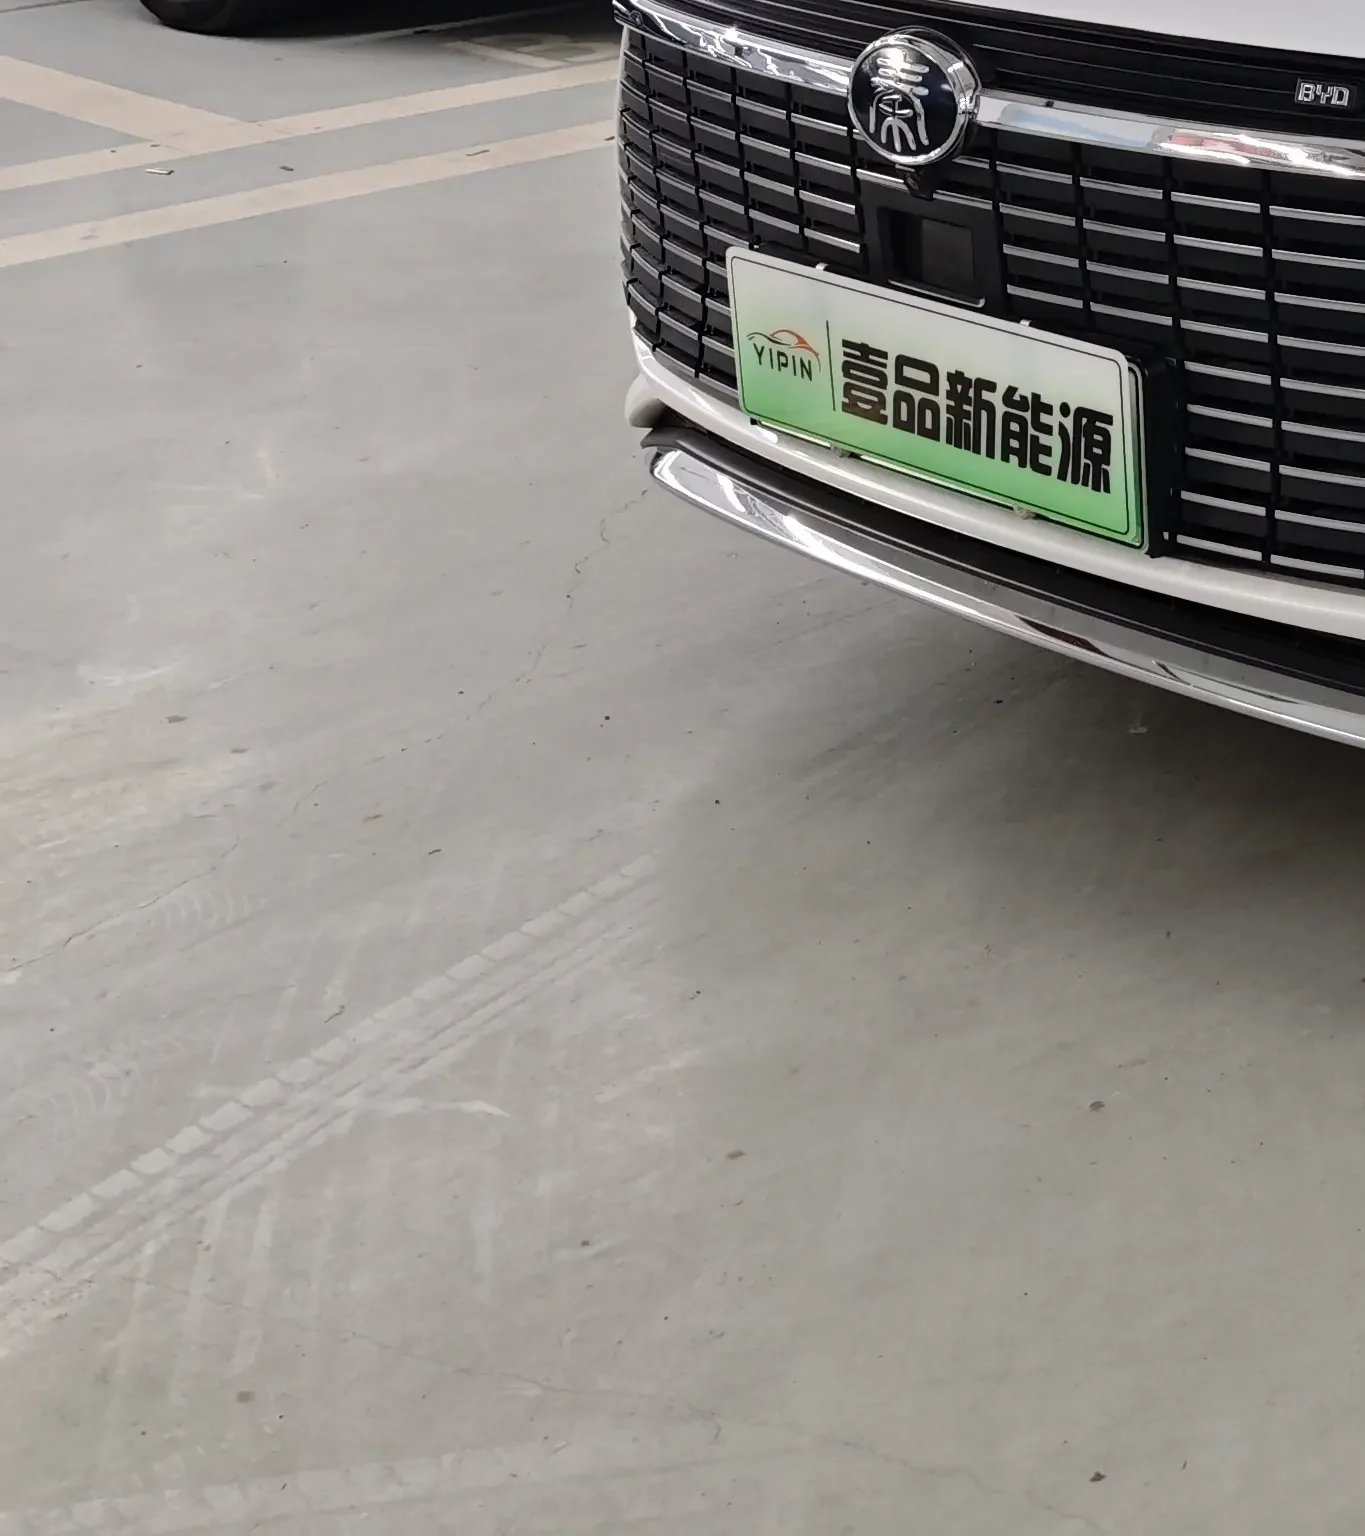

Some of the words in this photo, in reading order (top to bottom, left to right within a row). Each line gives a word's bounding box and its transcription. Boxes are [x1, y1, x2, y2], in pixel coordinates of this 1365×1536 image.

[1297, 82, 1350, 107] BYD
[752, 342, 814, 382] YIPIN
[841, 338, 1114, 494] 壹品新能源
